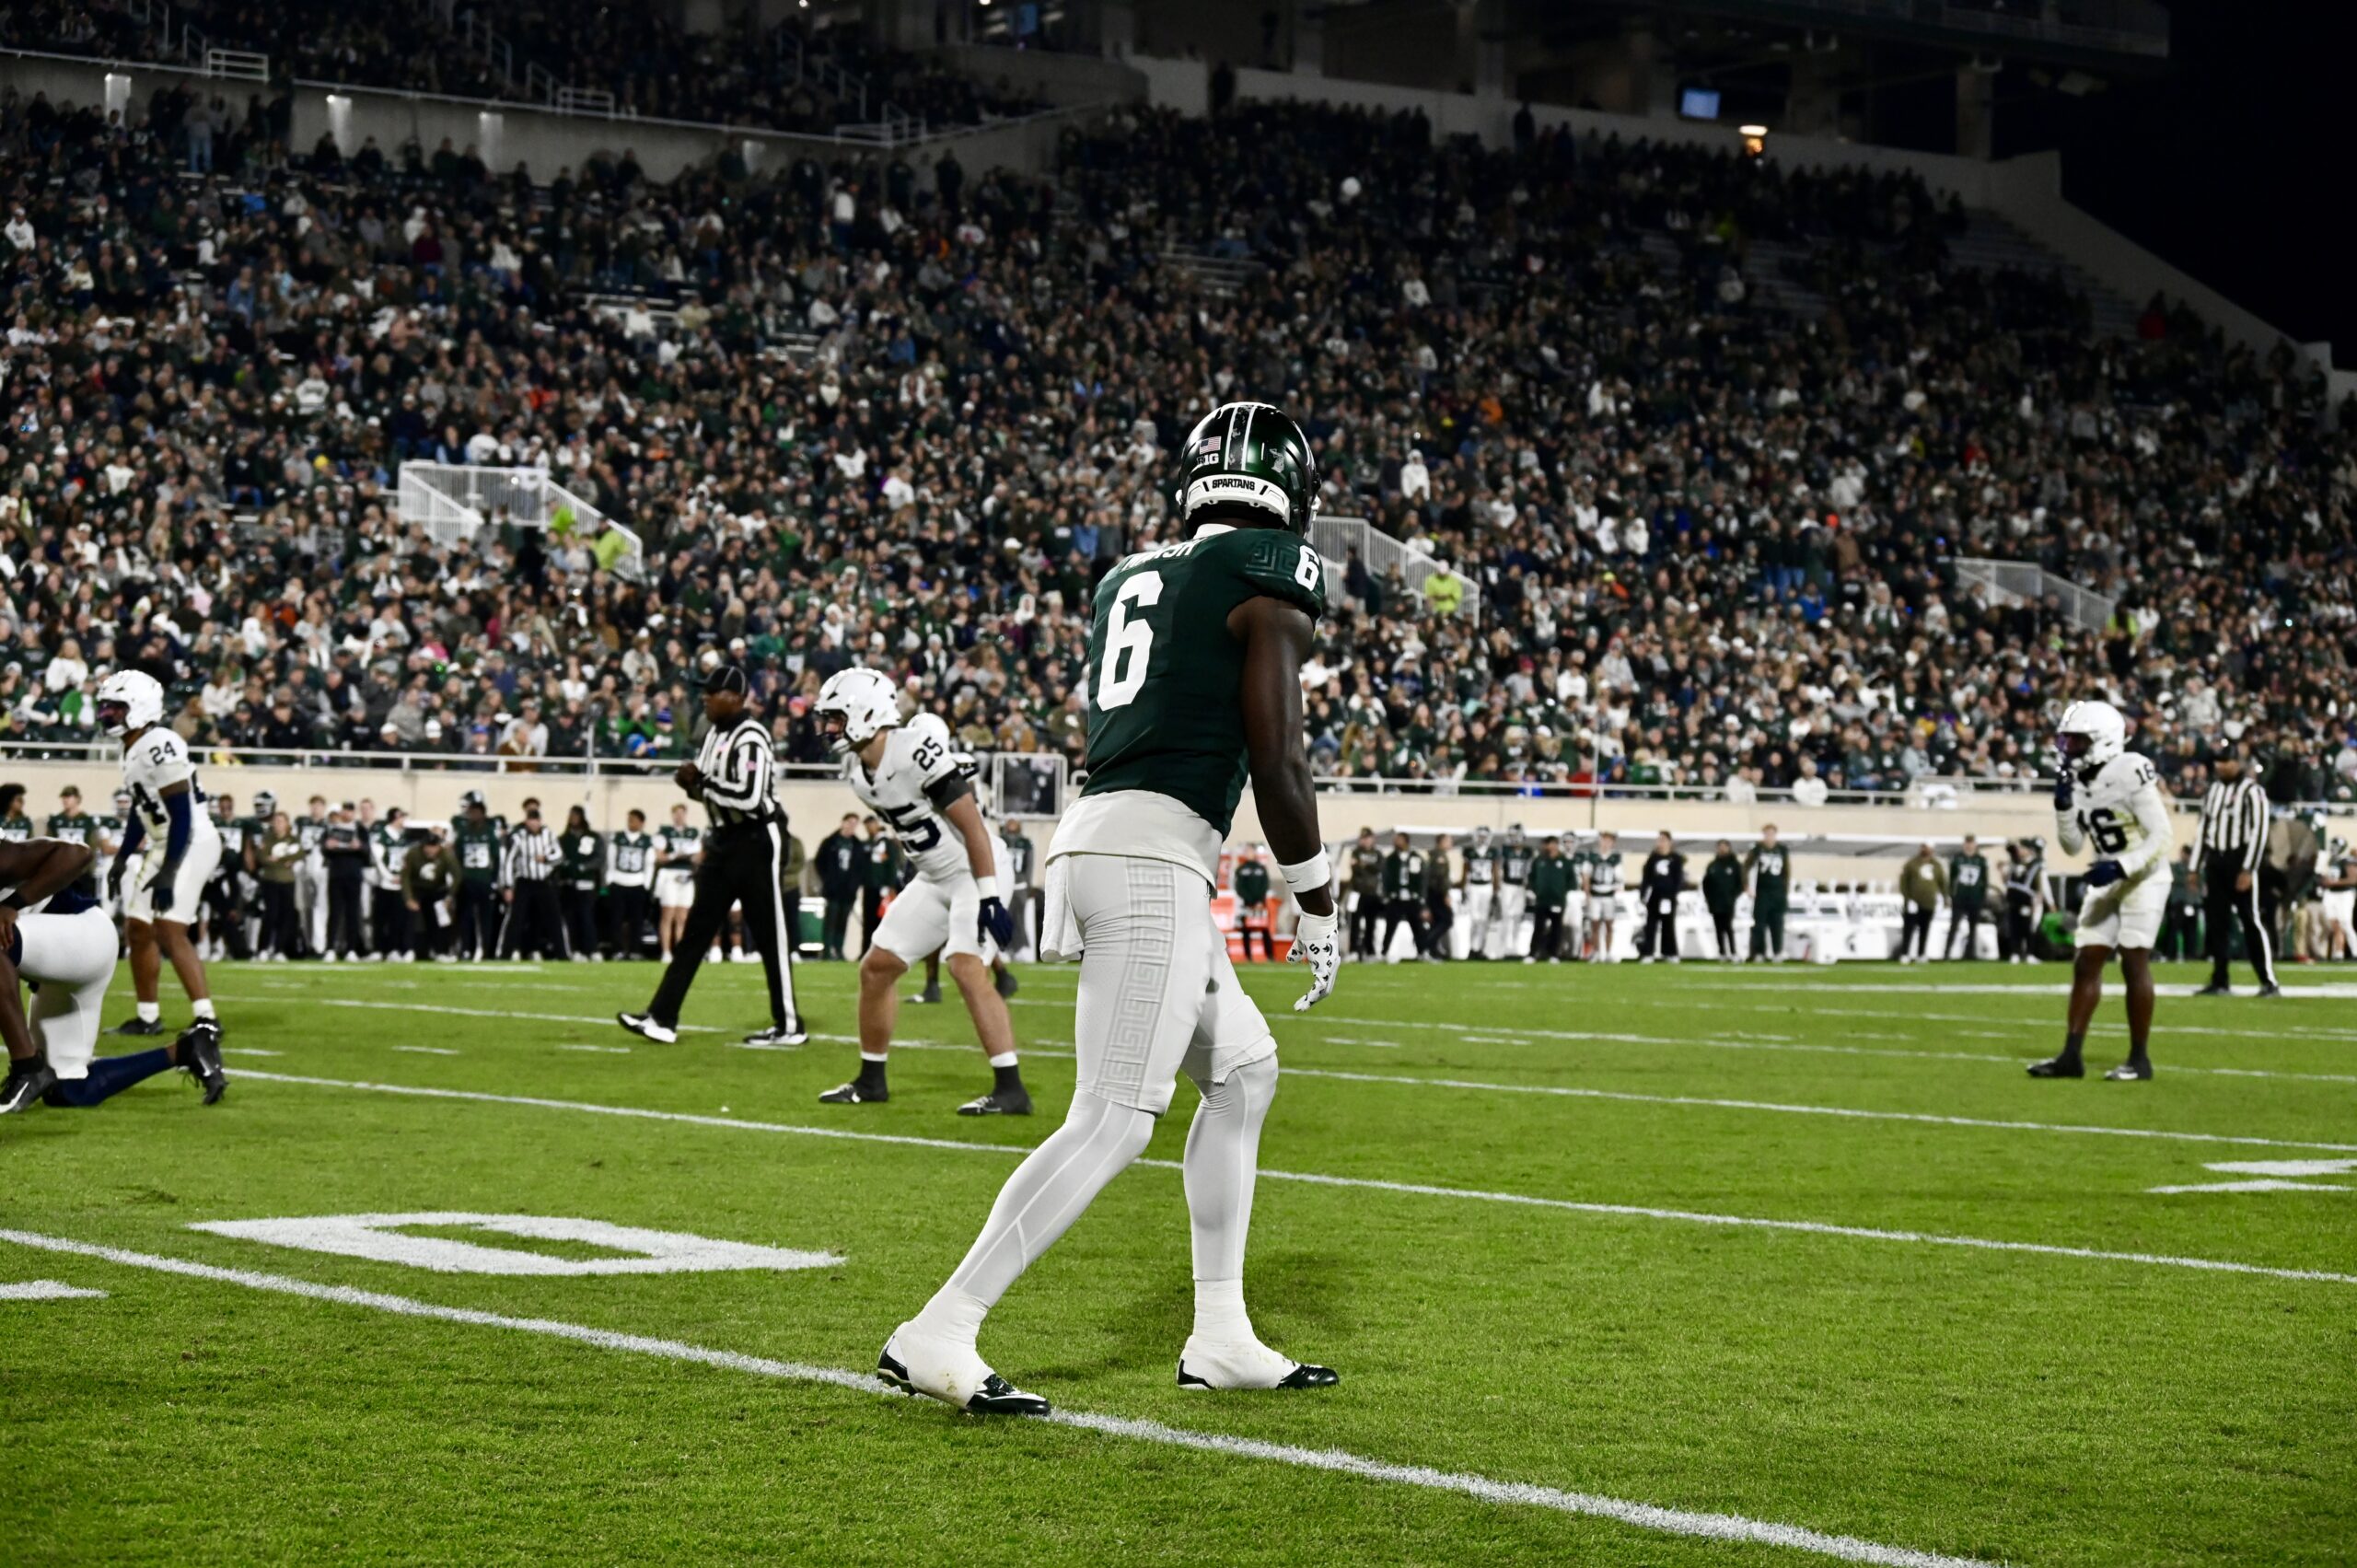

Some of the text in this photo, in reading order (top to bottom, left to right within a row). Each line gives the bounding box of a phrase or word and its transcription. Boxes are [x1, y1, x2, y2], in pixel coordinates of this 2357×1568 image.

[1212, 478, 1256, 491] SPARTANS
[1295, 544, 1320, 592] 6
[1097, 570, 1165, 712] 6
[149, 740, 176, 766] 24
[912, 736, 943, 772] 25
[133, 781, 167, 827] 4
[877, 800, 941, 853] 5
[2077, 807, 2129, 854] 16
[1309, 943, 1320, 955] S
